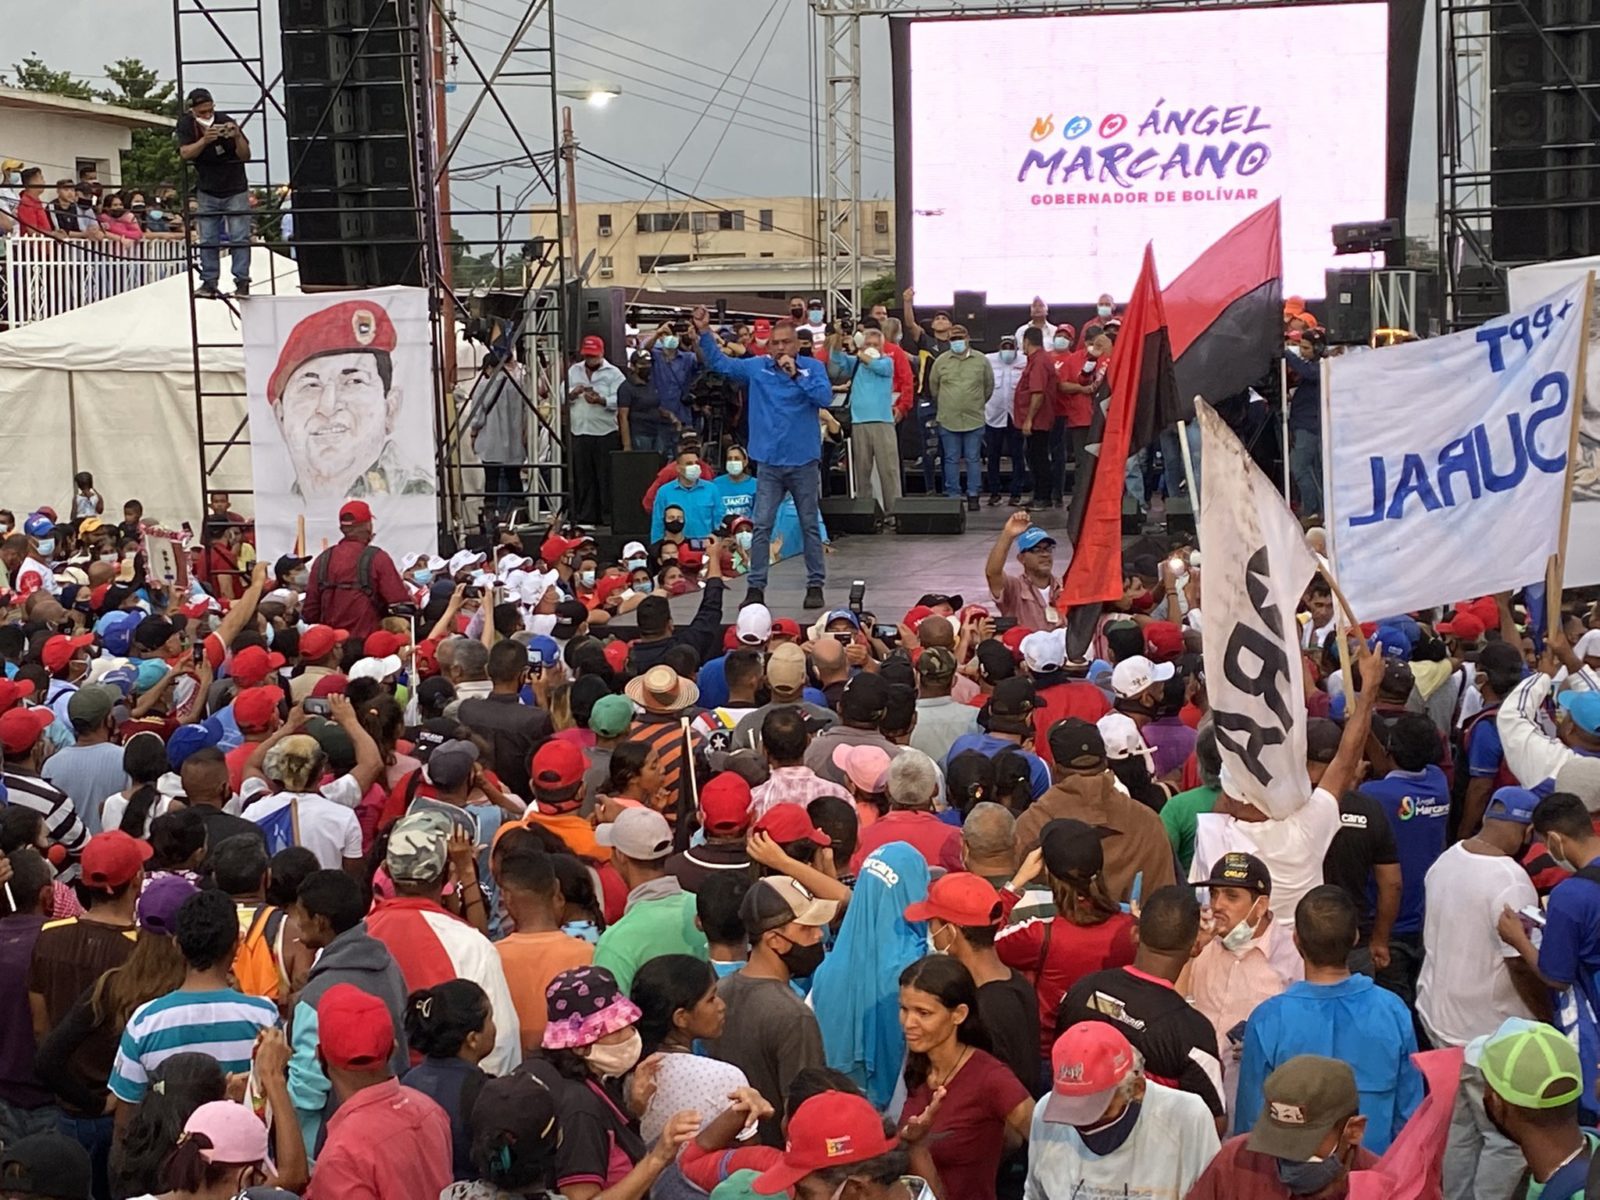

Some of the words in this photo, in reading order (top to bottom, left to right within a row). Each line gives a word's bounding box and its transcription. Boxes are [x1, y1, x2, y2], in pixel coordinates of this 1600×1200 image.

[1138, 96, 1272, 136] ÁNGEL
[1017, 140, 1272, 189] MARCANO
[1031, 191, 1149, 206] GOBERNADOR
[1154, 189, 1177, 203] DE
[1181, 186, 1259, 202] BOLÍVAR
[1341, 813, 1368, 825] cano
